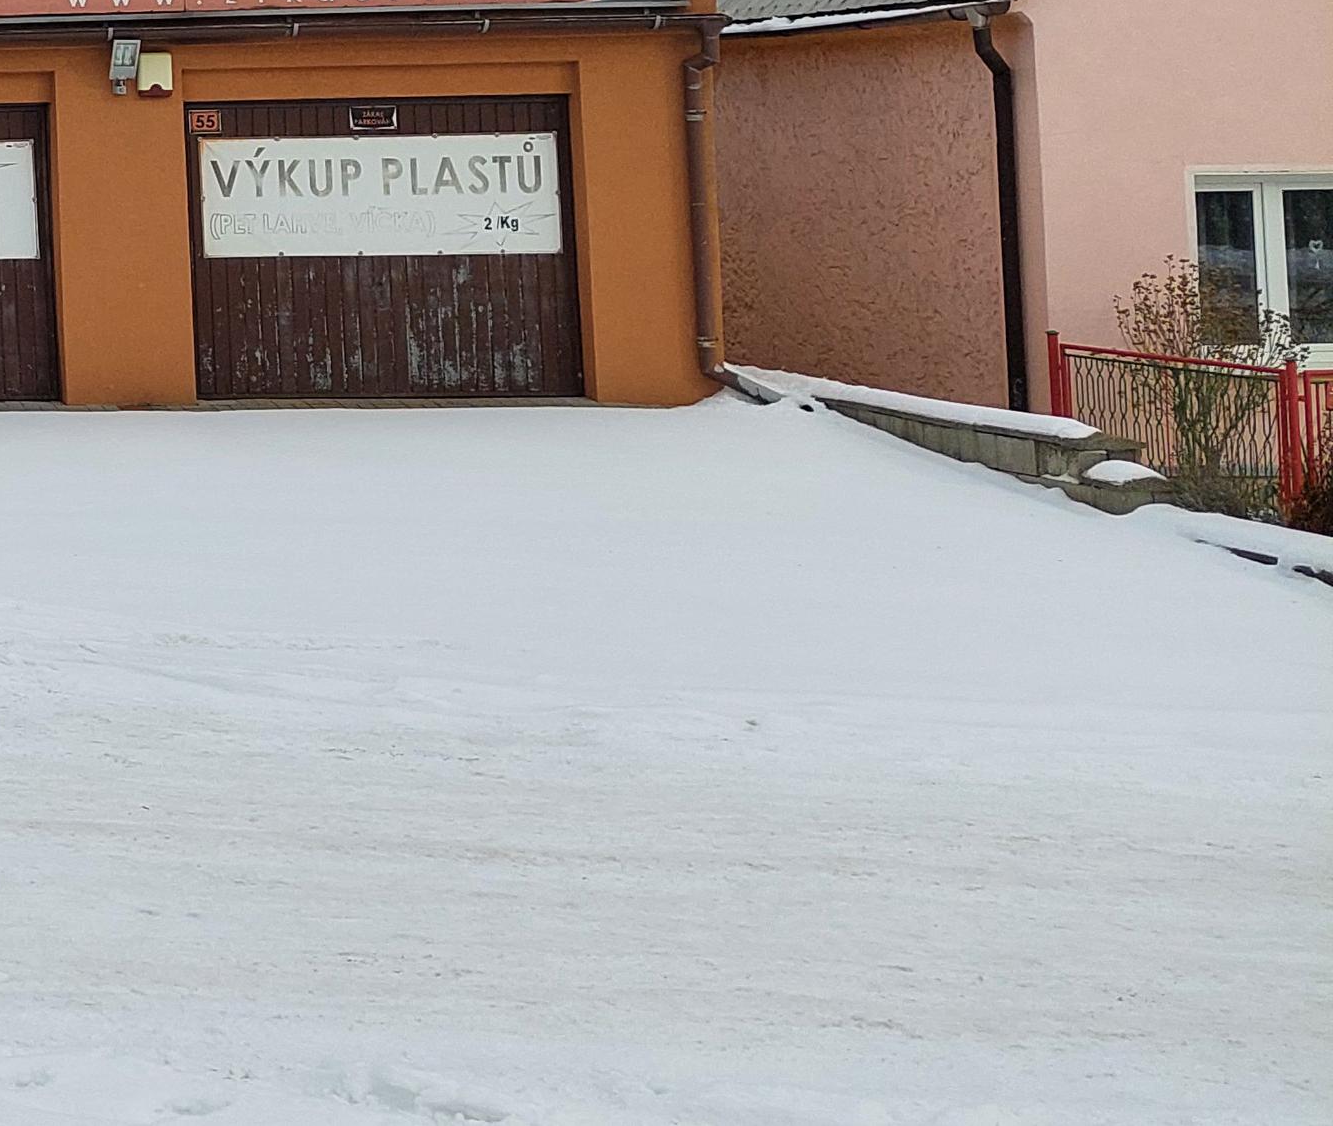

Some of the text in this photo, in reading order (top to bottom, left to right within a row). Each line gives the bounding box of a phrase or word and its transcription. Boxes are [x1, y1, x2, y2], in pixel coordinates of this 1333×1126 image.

[195, 114, 215, 128] 55
[208, 141, 543, 198] VÝKUP PLASTŮ
[484, 217, 493, 230] 2
